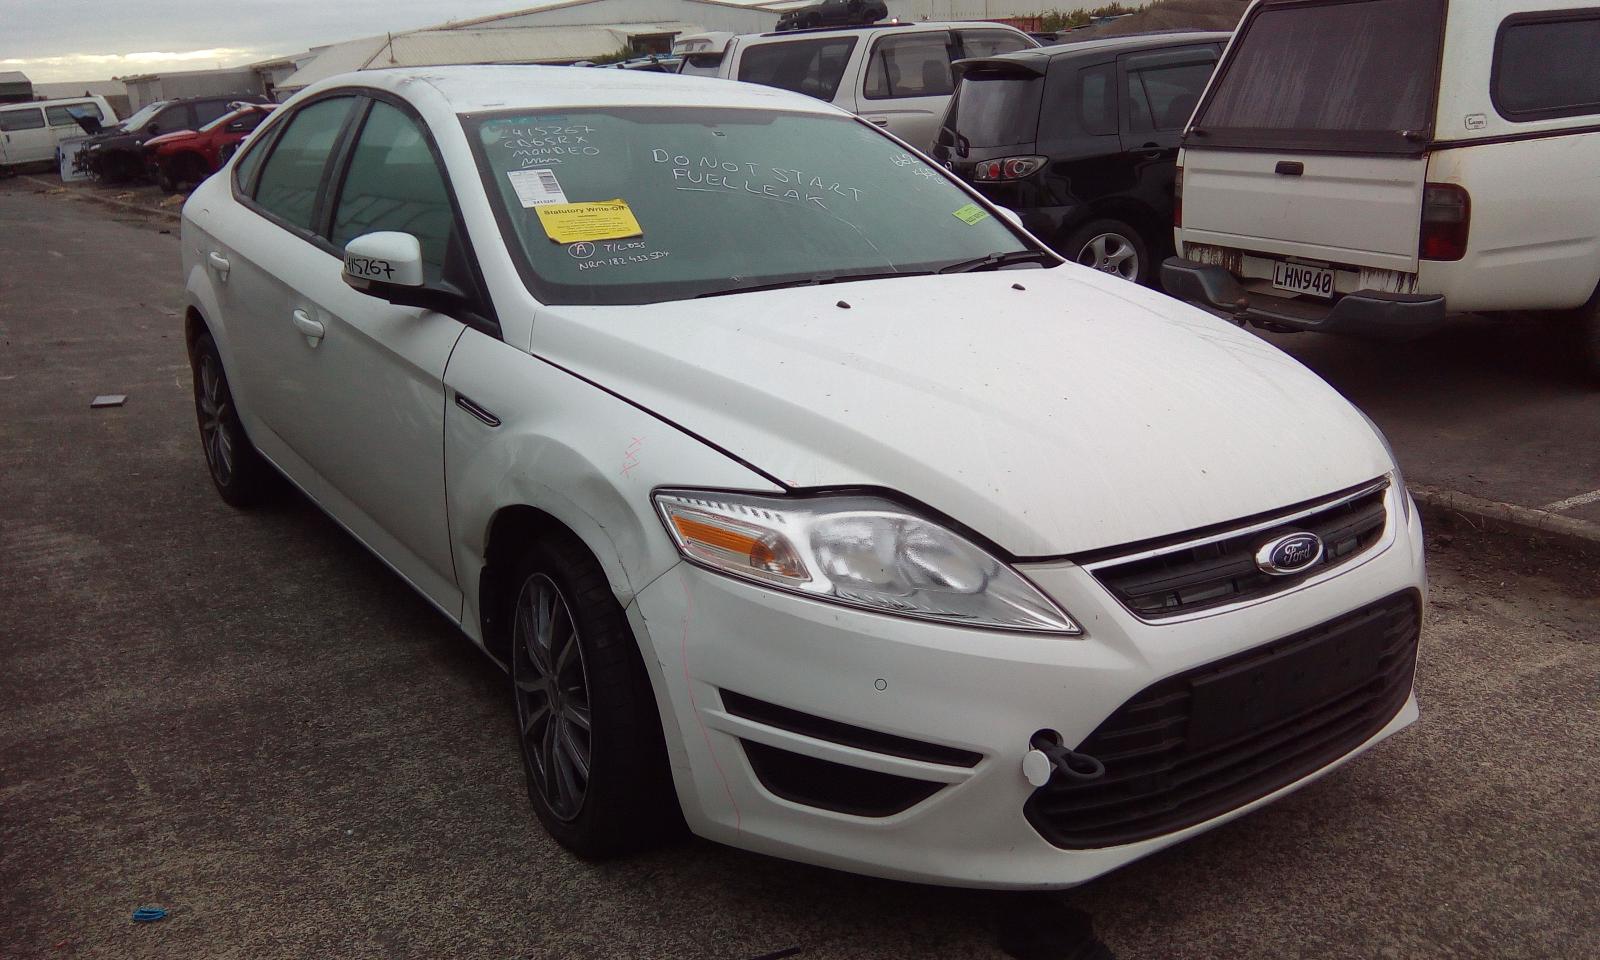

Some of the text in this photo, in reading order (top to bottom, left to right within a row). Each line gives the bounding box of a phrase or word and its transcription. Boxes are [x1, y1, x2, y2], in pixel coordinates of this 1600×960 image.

[512, 147, 599, 158] MONDEO
[673, 169, 827, 210] FUEL LEAK
[772, 167, 863, 201] START
[544, 207, 584, 216] Statutory
[1275, 265, 1332, 293] LHN940
[1284, 542, 1310, 563] Ford
